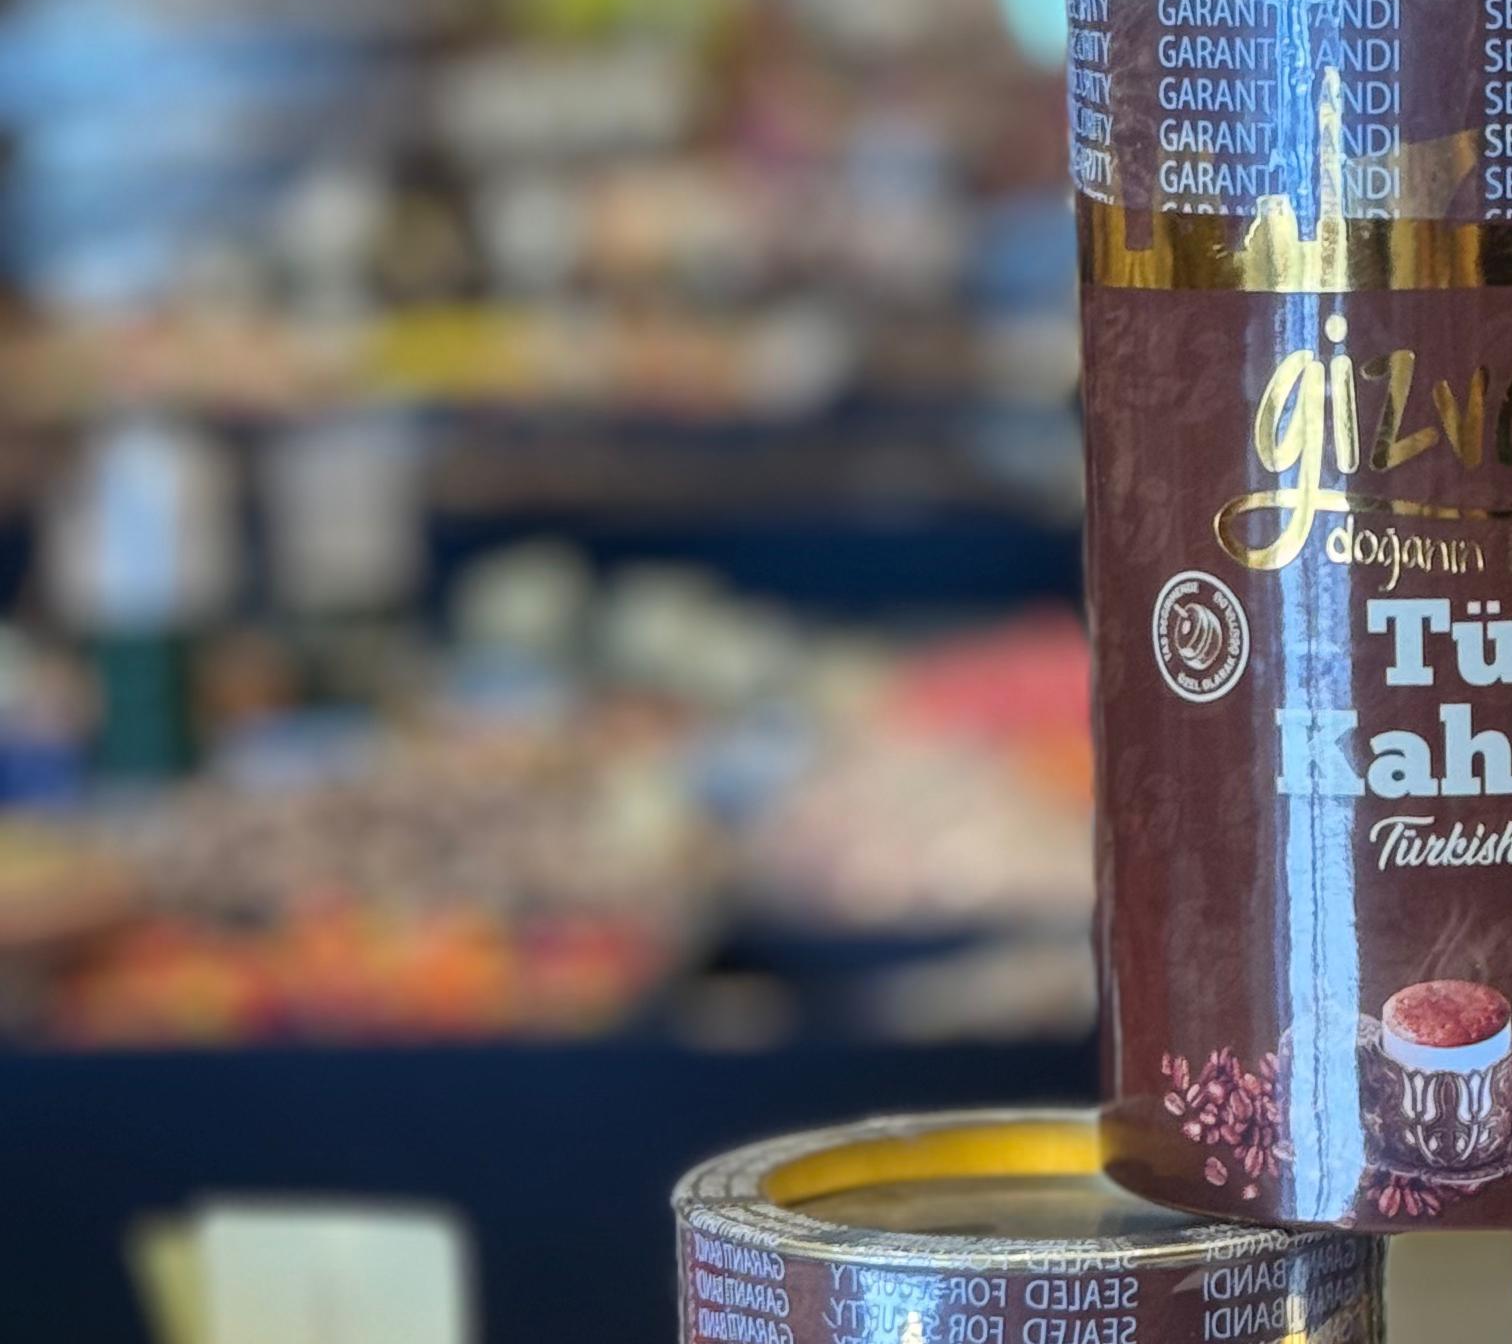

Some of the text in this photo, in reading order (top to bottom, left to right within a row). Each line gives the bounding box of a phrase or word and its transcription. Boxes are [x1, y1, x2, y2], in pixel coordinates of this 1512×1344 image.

[1158, 35, 1400, 72] GARANT ANDI
[1158, 77, 1277, 113] GARANT
[1158, 119, 1277, 155] GARANT
